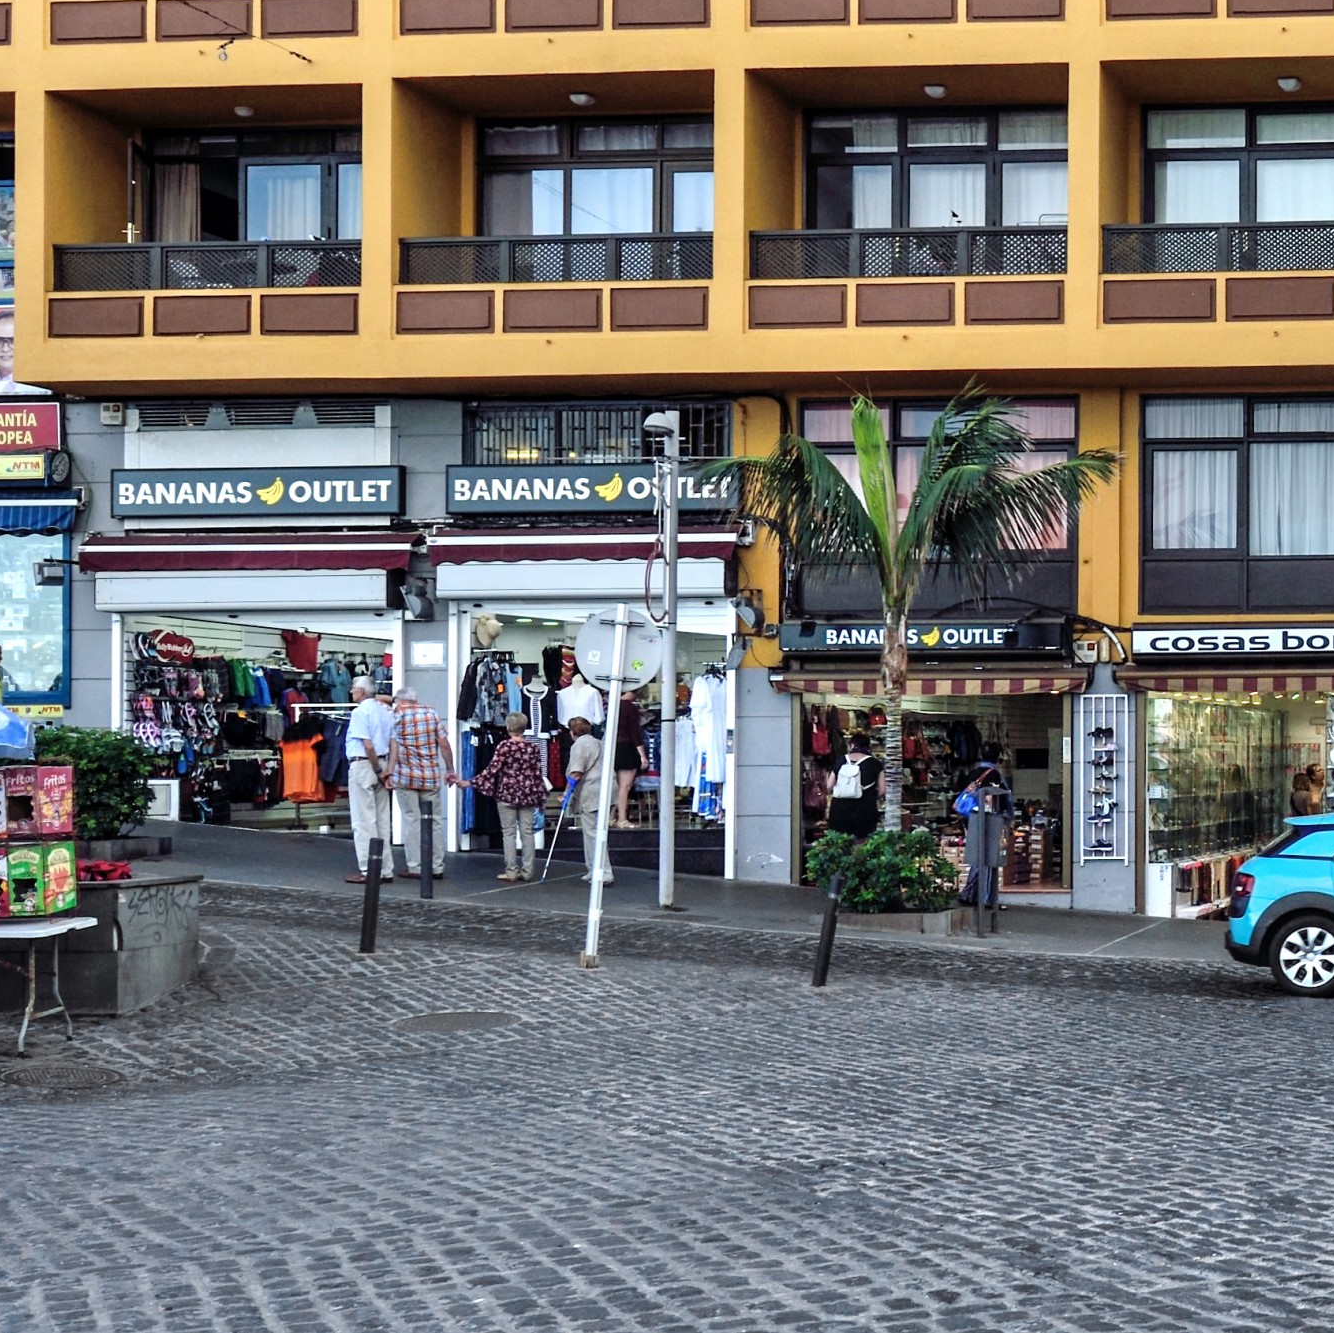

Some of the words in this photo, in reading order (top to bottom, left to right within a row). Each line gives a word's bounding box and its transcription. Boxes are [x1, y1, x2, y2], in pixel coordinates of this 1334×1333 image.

[12, 461, 41, 470] NTM
[119, 481, 252, 505] BANANAS
[288, 479, 392, 504] OUTLET
[454, 478, 590, 502] BANANAS
[826, 628, 918, 645] BANAS
[1149, 634, 1271, 652] cosas
[6, 774, 35, 786] Fritos
[43, 774, 67, 789] Fritos
